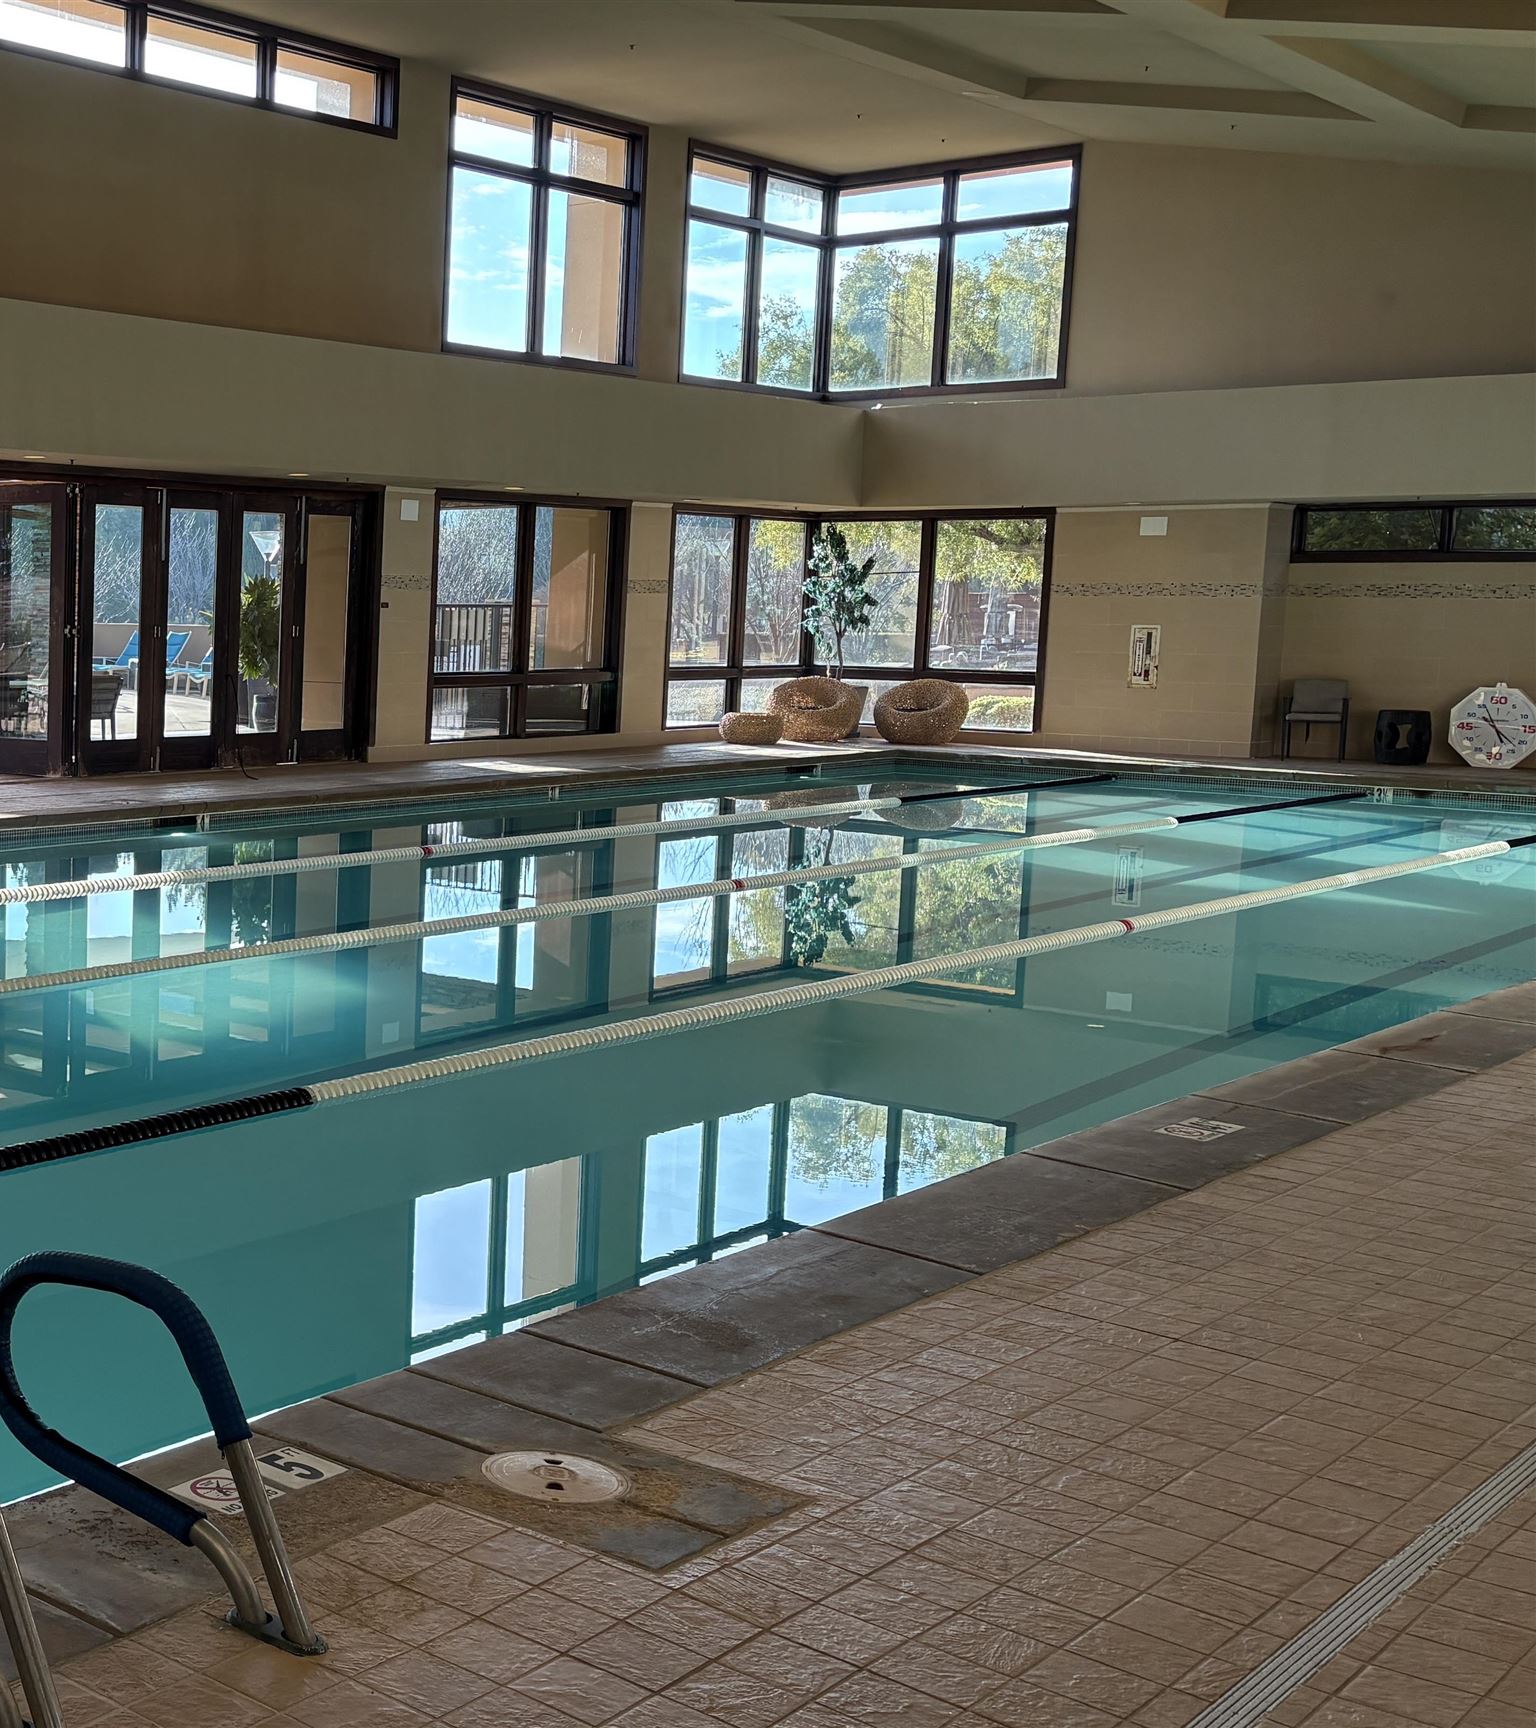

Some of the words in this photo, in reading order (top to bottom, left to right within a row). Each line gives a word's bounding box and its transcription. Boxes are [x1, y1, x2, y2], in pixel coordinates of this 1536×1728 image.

[1490, 696, 1508, 705] 60
[1457, 722, 1473, 730] 45
[1521, 725, 1536, 733] 15
[1486, 752, 1502, 760] 30
[280, 1448, 300, 1457] FT
[257, 1454, 324, 1480] 5
[221, 1503, 242, 1513] NO
